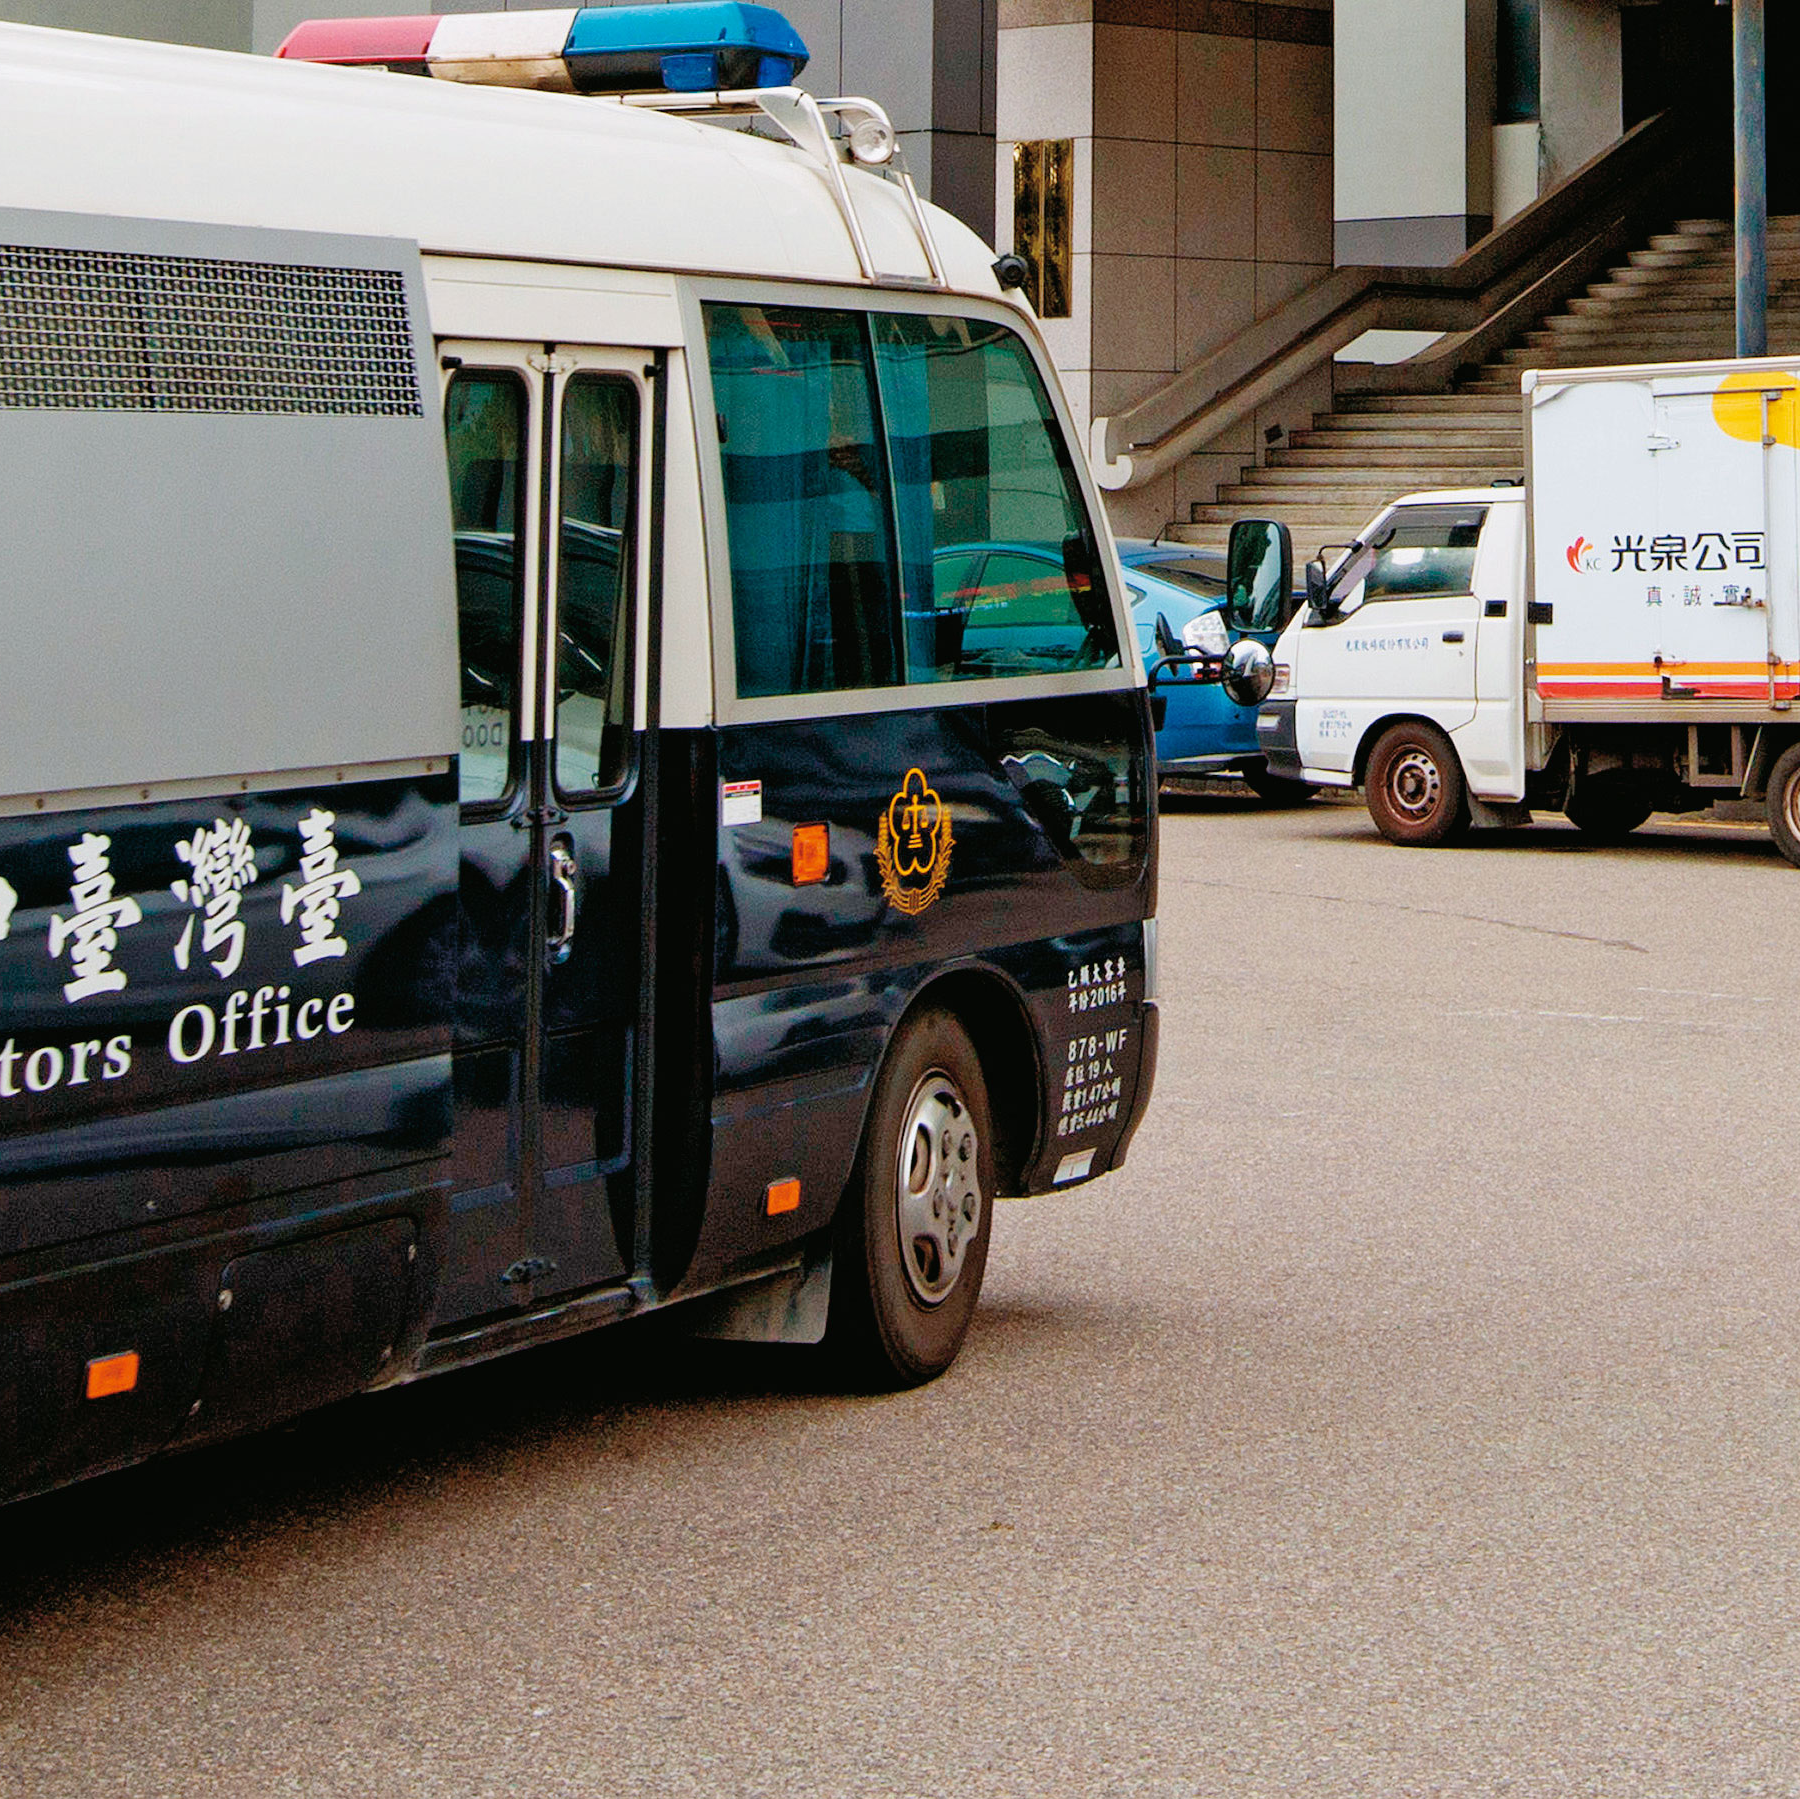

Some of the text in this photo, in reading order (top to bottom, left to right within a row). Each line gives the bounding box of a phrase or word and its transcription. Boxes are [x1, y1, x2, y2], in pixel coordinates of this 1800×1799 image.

[1585, 557, 1601, 571] KC
[1610, 532, 1766, 572] 光泉公司
[167, 986, 356, 1068] Office
[1068, 1028, 1128, 1062] 878-WF
